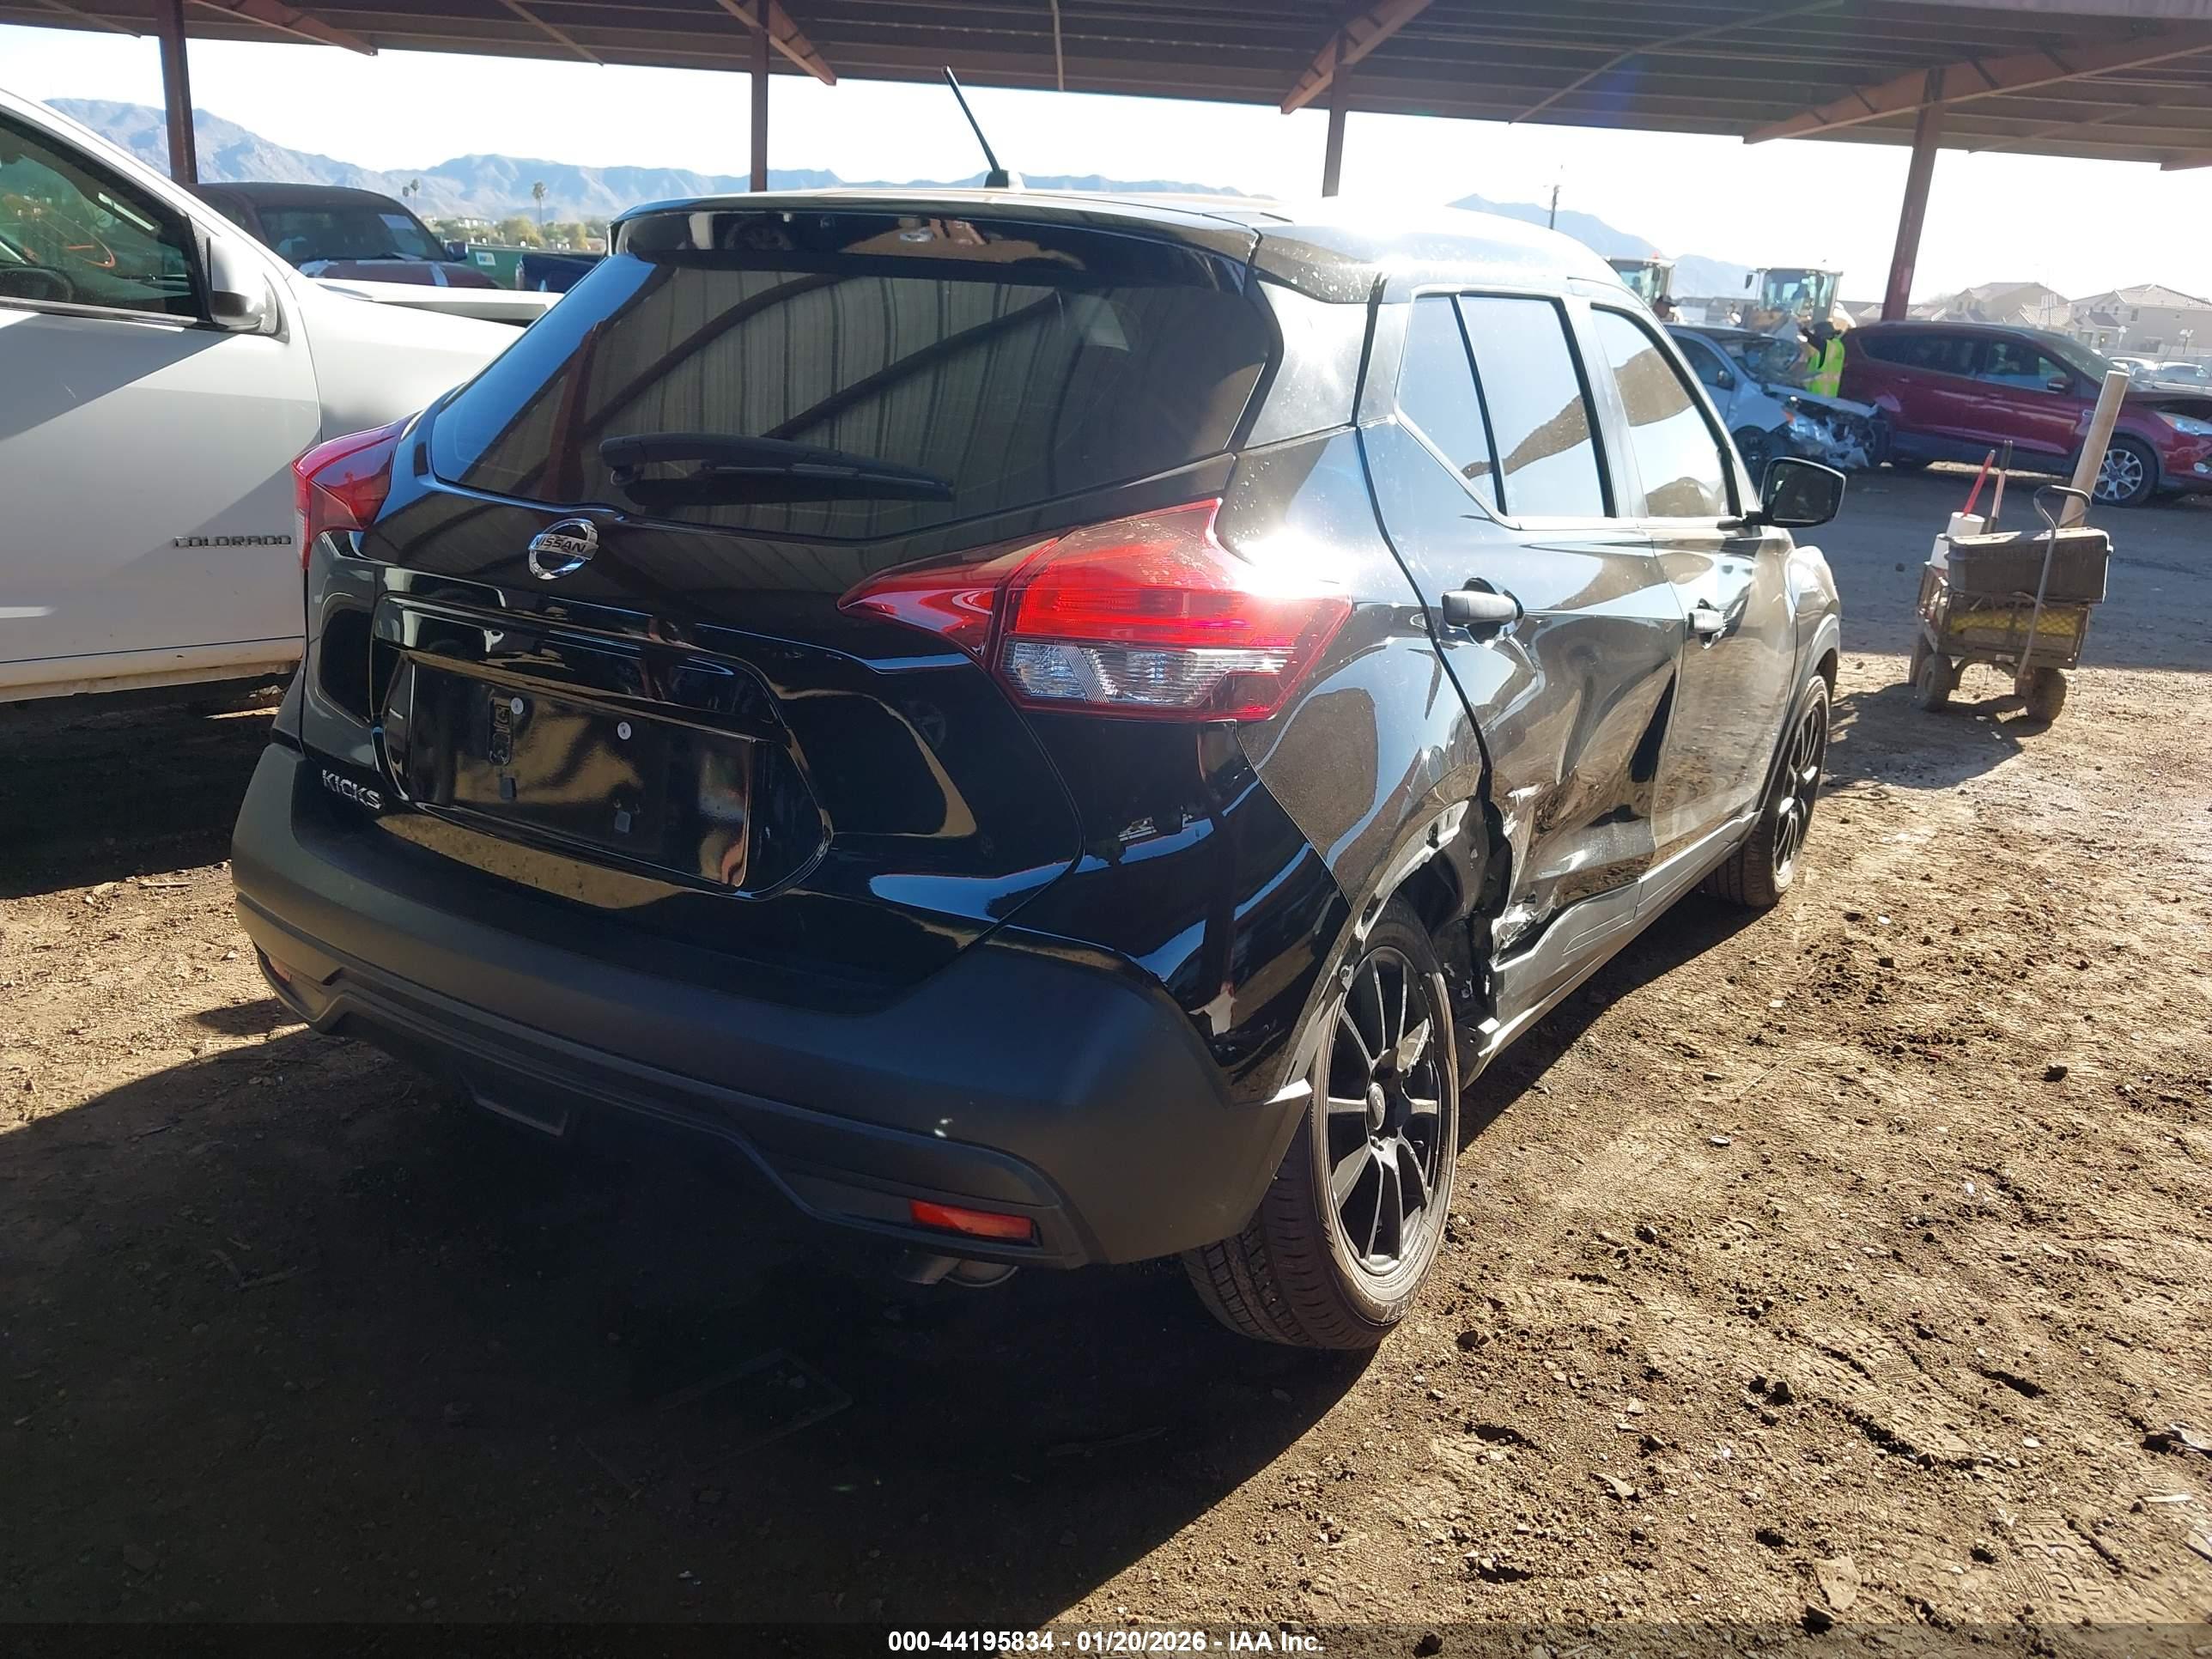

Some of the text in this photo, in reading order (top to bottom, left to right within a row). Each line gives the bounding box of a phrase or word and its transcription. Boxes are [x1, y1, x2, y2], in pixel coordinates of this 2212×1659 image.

[173, 535, 291, 548] COLORADO
[534, 535, 586, 553] NISSAN
[322, 769, 381, 809] KICKS
